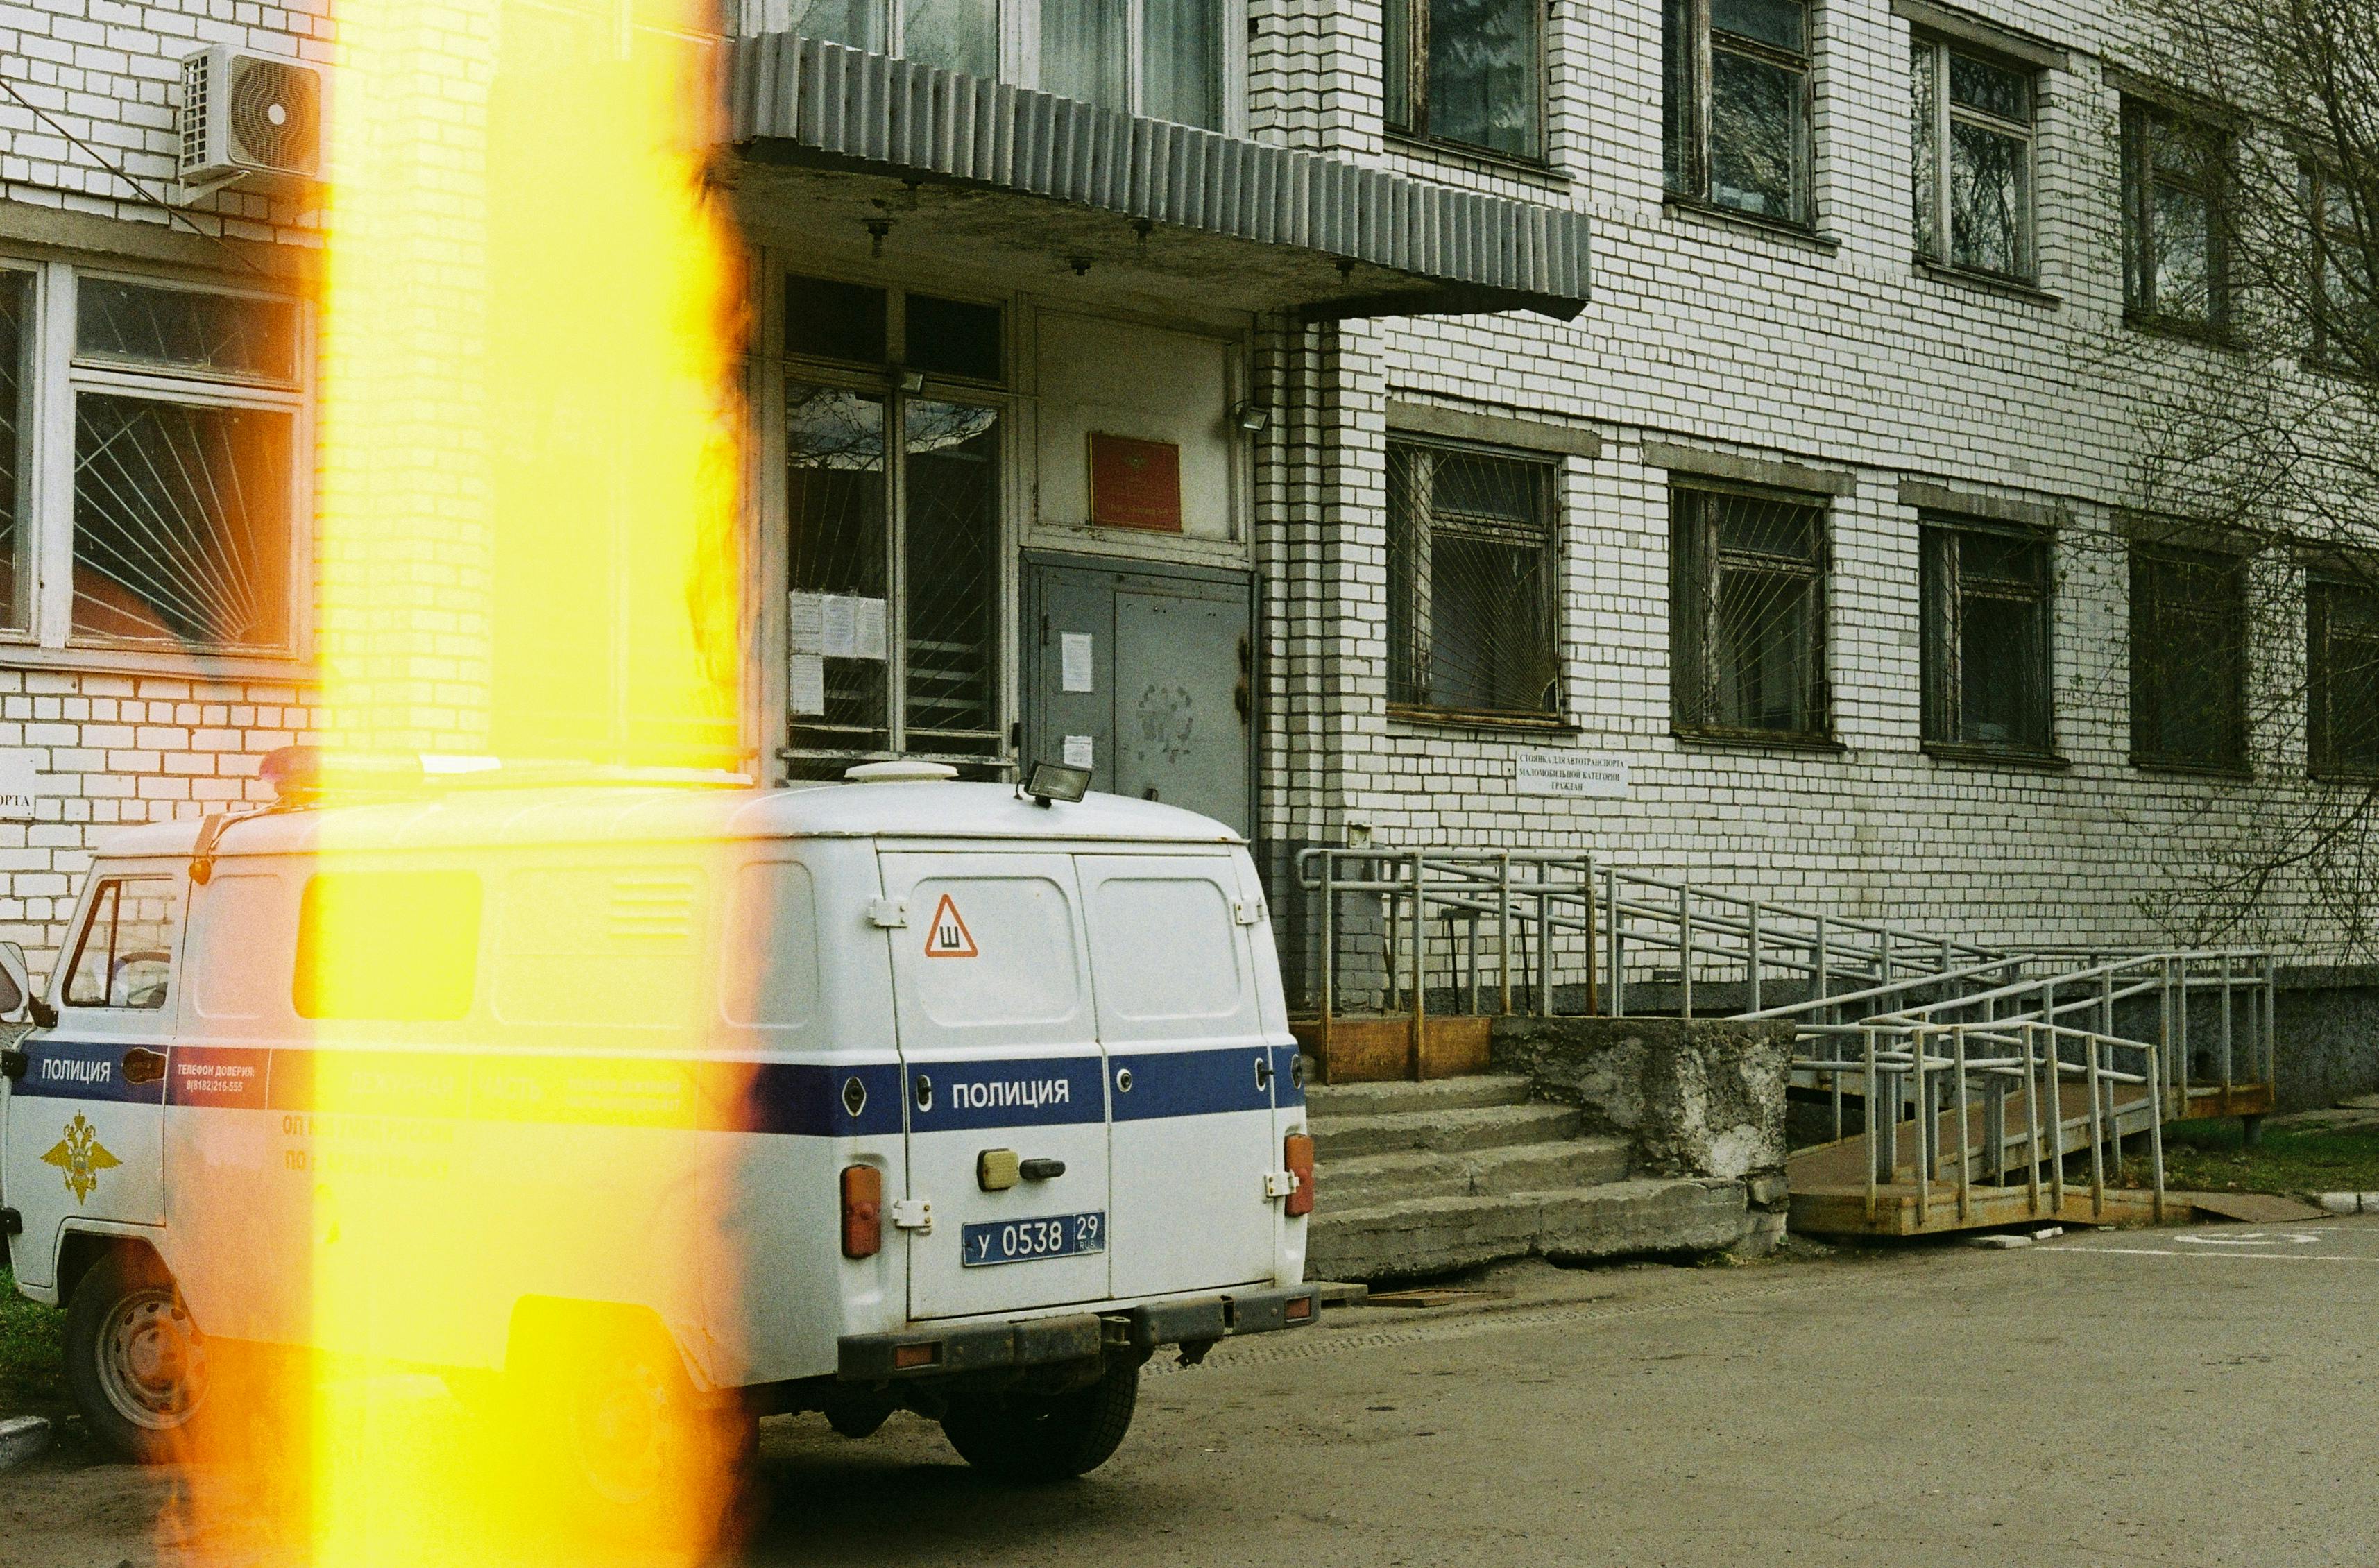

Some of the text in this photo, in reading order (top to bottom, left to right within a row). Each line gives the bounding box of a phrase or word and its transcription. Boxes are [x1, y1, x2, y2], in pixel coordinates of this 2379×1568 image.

[1519, 754, 1624, 768] СТОЯНКА ДЛЯ АВТОТРАНСПОРТА
[1519, 768, 1620, 781] МАЛОМОБИЛЬНОЙ КАТЕГОРИИ
[1551, 781, 1583, 791] ГРАЖДАН
[940, 926, 960, 948] Ш
[42, 1059, 111, 1084] ПОЛИЦИЯ
[178, 1064, 255, 1077] ТЕЛЕФОН ДОВЕРИЯ:
[953, 1079, 1070, 1109] ПОЛИЦИЯ
[282, 1115, 303, 1136] ОП
[284, 1150, 307, 1171] ПО
[1002, 1221, 1063, 1257] 0538
[1077, 1215, 1099, 1241] 29
[1079, 1240, 1096, 1250] RUS
